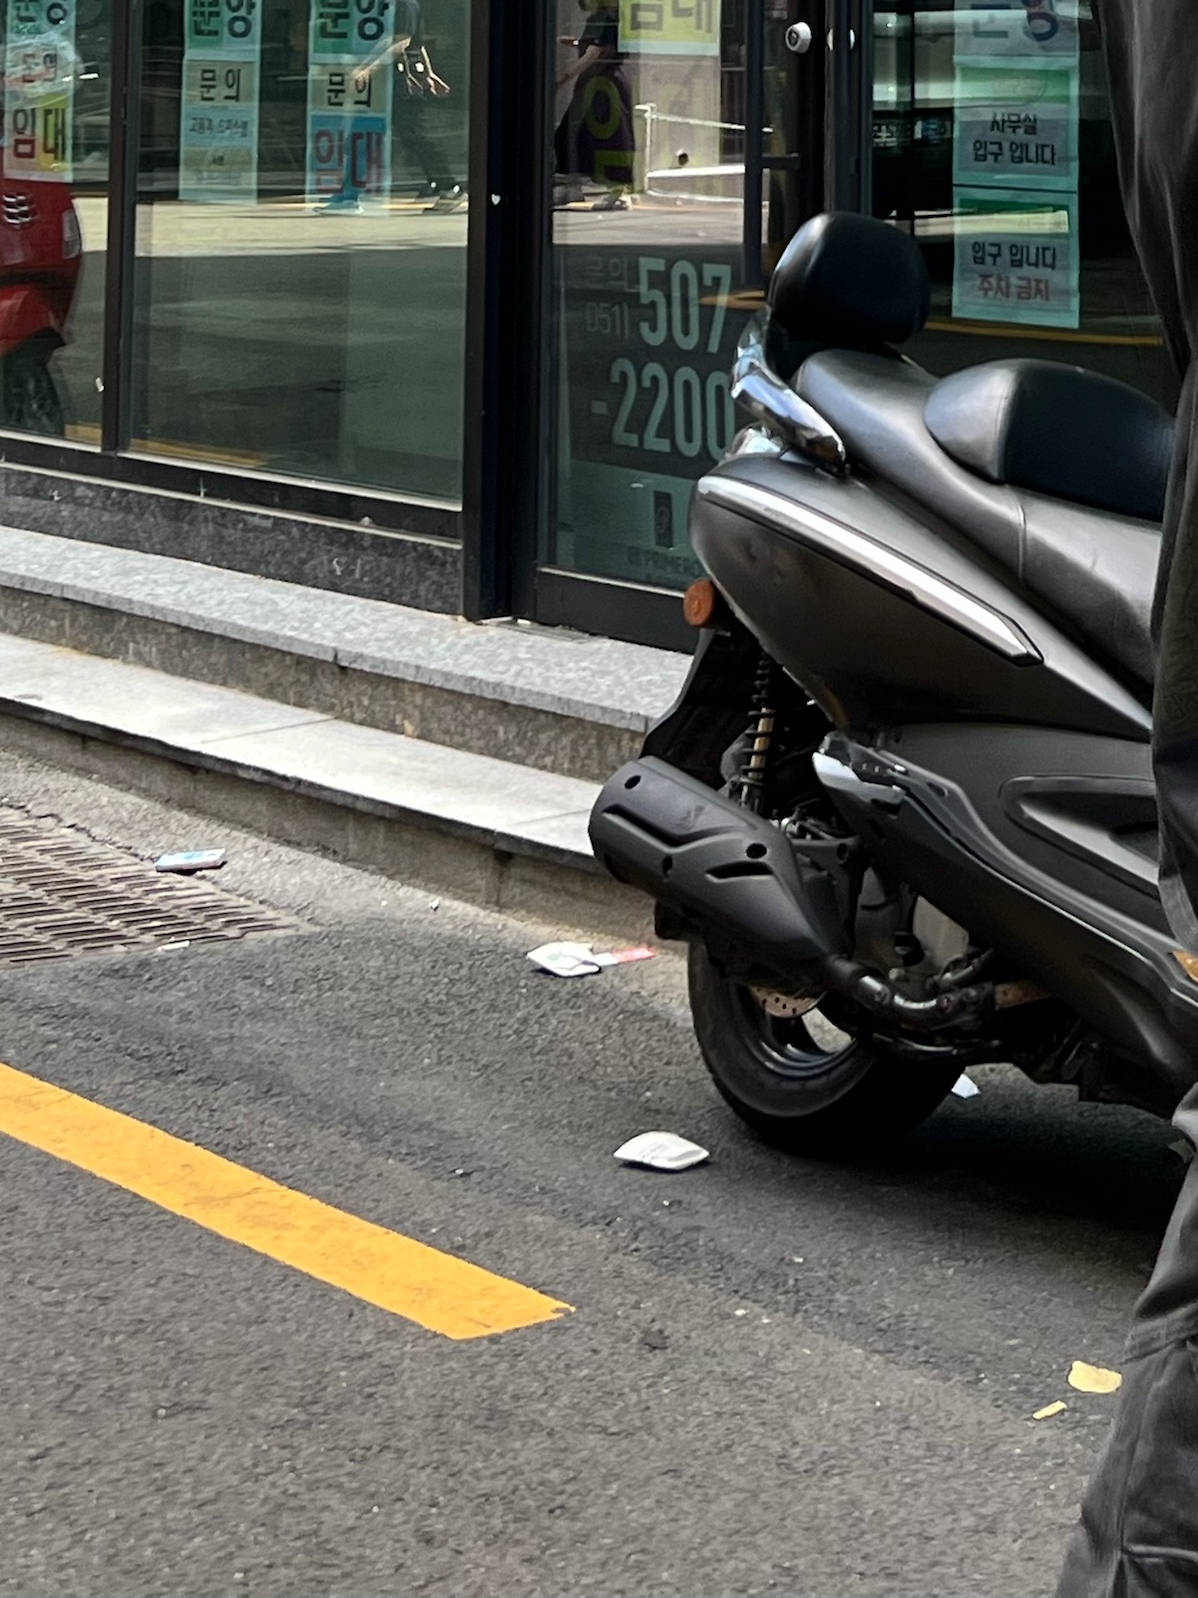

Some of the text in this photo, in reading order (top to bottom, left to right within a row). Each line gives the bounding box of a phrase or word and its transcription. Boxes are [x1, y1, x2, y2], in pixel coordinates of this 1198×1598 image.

[200, 68, 241, 102] 문의
[14, 107, 66, 161] 임대
[989, 112, 1037, 134] 사무실
[314, 128, 384, 195] 임대
[972, 140, 1056, 166] 입구 입니다
[971, 241, 1057, 270] 입구 입니다
[638, 255, 731, 354] 507
[977, 273, 1050, 302] 주차 금지
[591, 357, 736, 462] -2200
